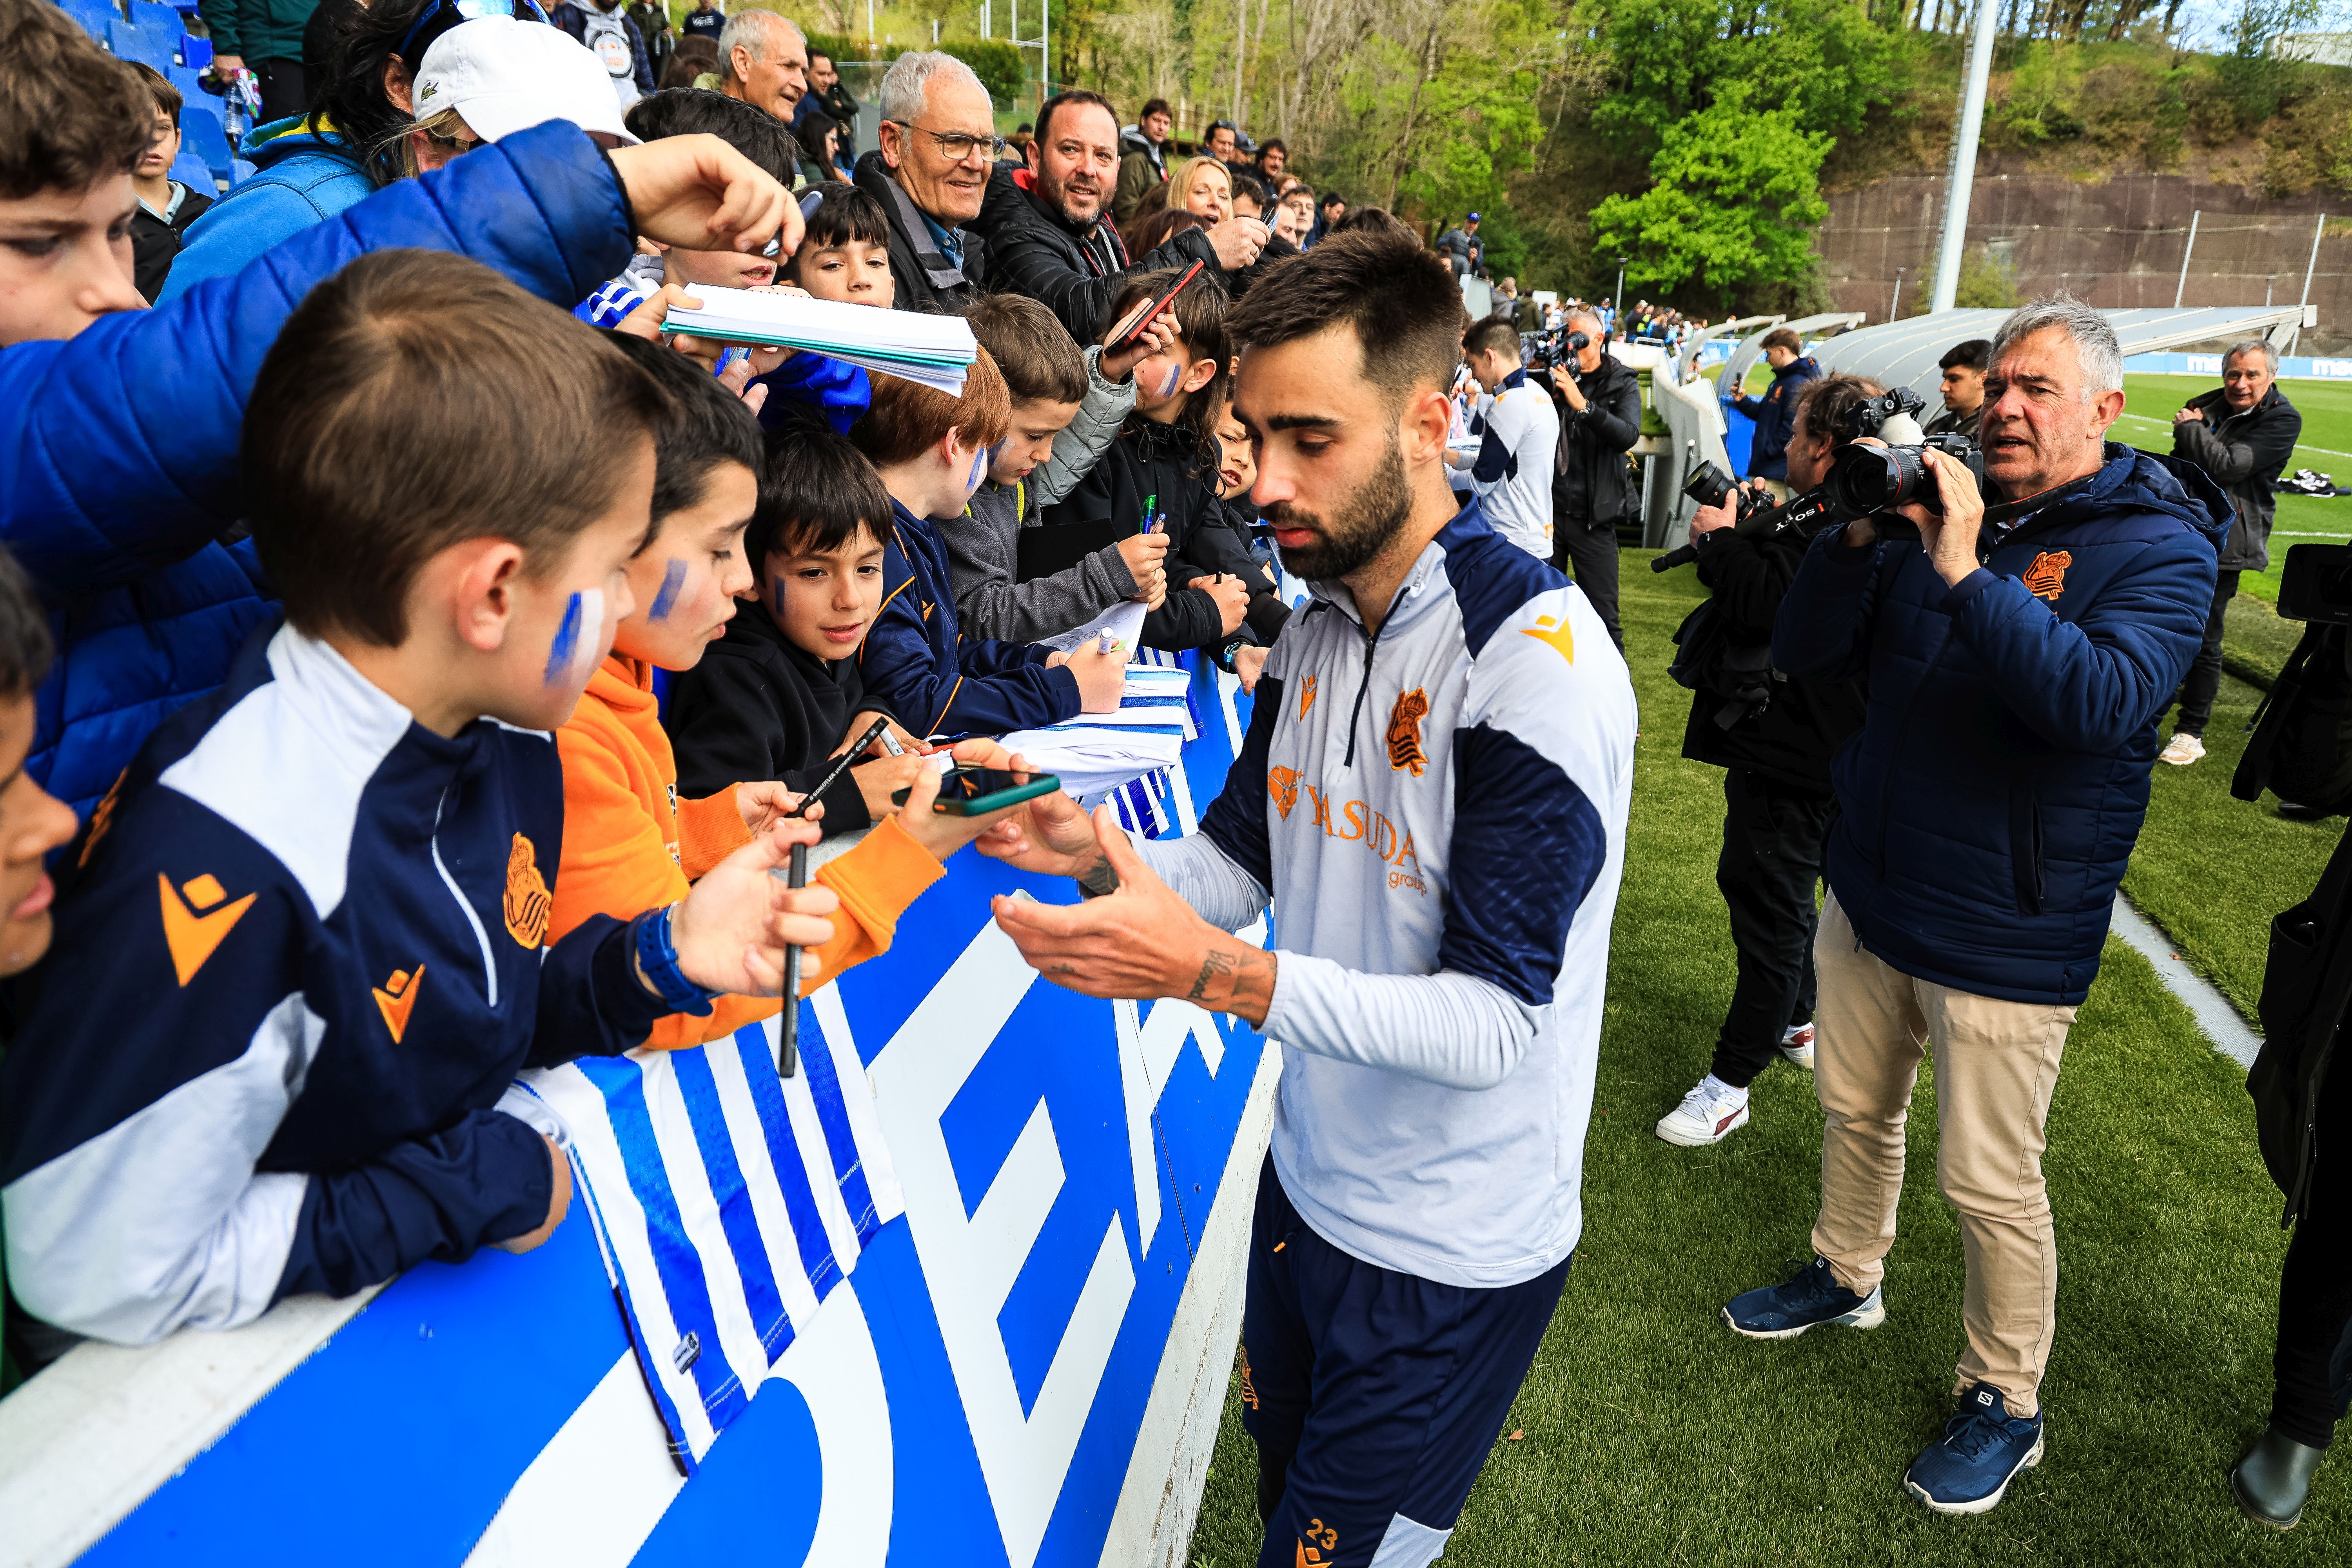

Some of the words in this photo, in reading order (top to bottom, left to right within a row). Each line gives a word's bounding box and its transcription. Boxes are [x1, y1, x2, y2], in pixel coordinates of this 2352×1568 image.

[1775, 508, 1815, 531] SOY
[812, 772, 836, 797] STAEDTLER
[835, 752, 855, 774] permanent
[1306, 785, 1424, 877] YASUDA
[1388, 871, 1427, 897] group
[1306, 1518, 1338, 1550] 23
